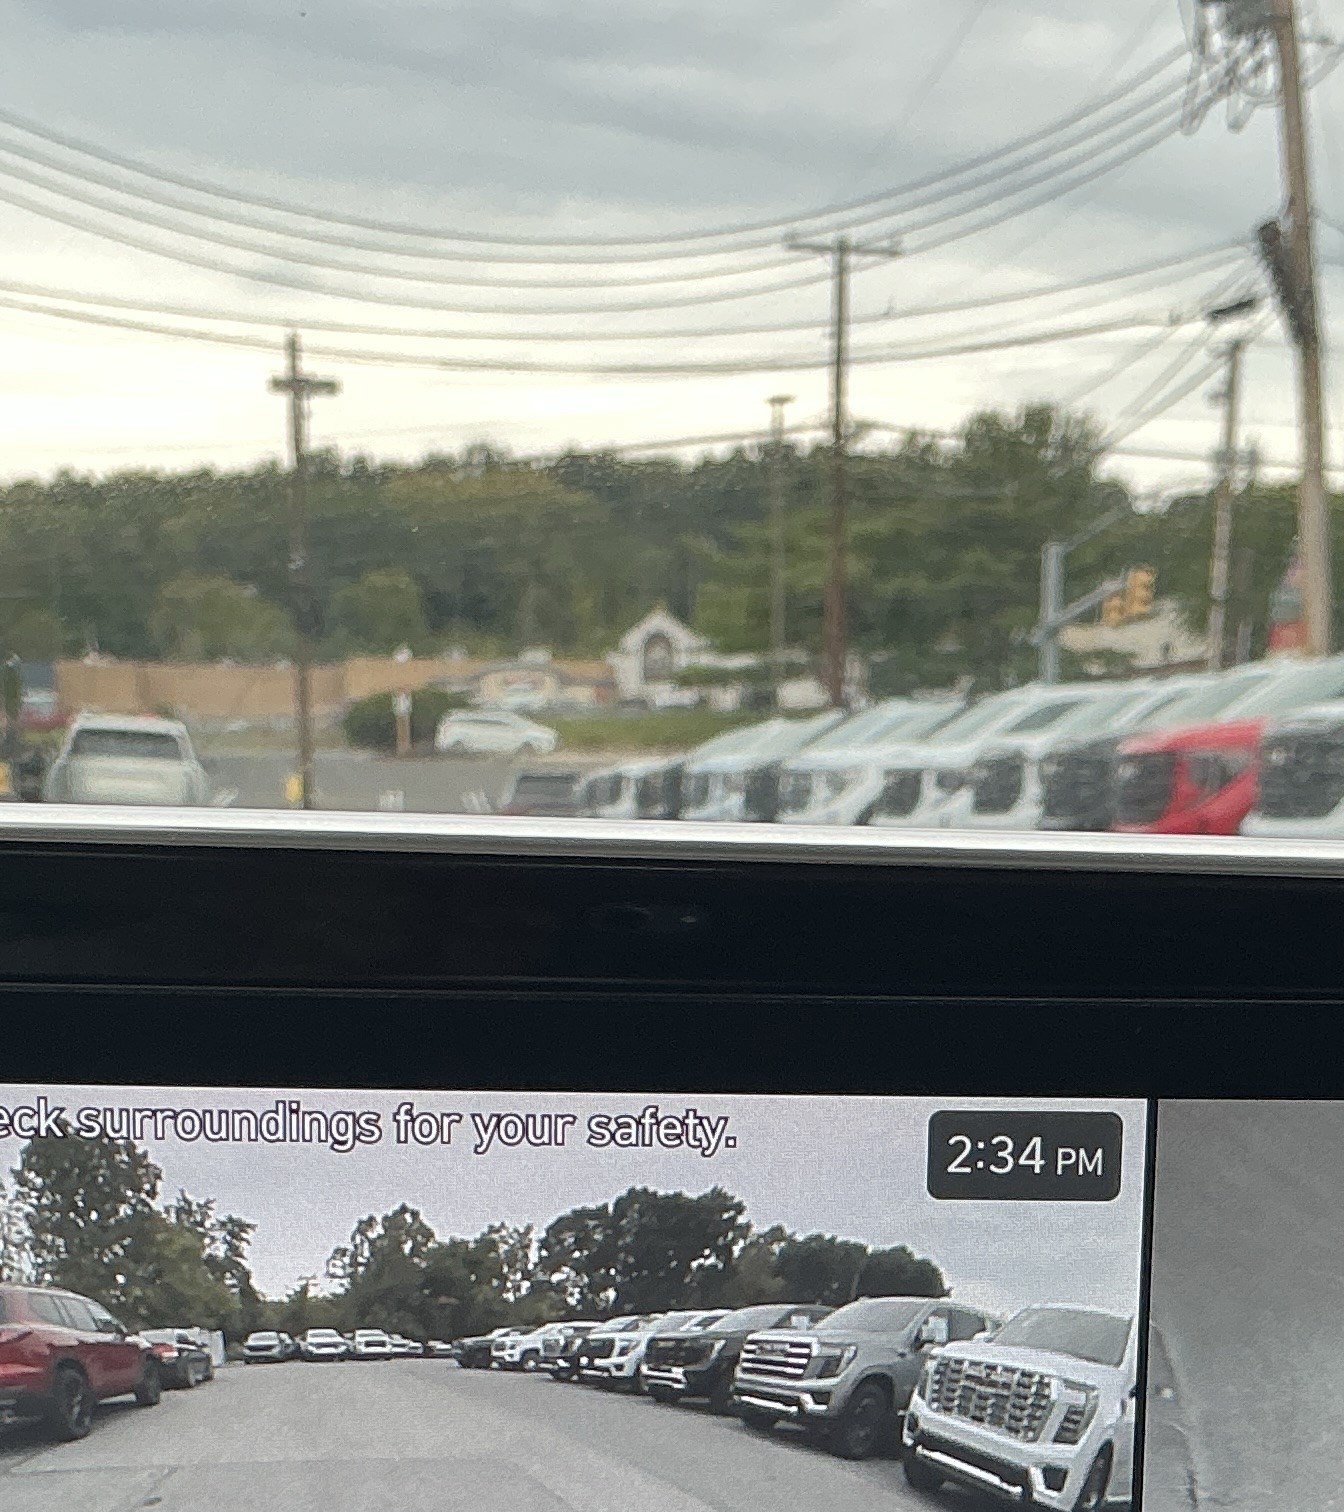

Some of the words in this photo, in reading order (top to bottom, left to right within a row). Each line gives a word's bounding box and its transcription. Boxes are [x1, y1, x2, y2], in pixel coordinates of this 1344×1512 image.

[75, 1099, 384, 1153] surroundings
[393, 1104, 462, 1145] for
[472, 1111, 576, 1155] your
[586, 1104, 739, 1157] safety.
[946, 1134, 1046, 1175] 2:34
[1056, 1147, 1104, 1176] PM
